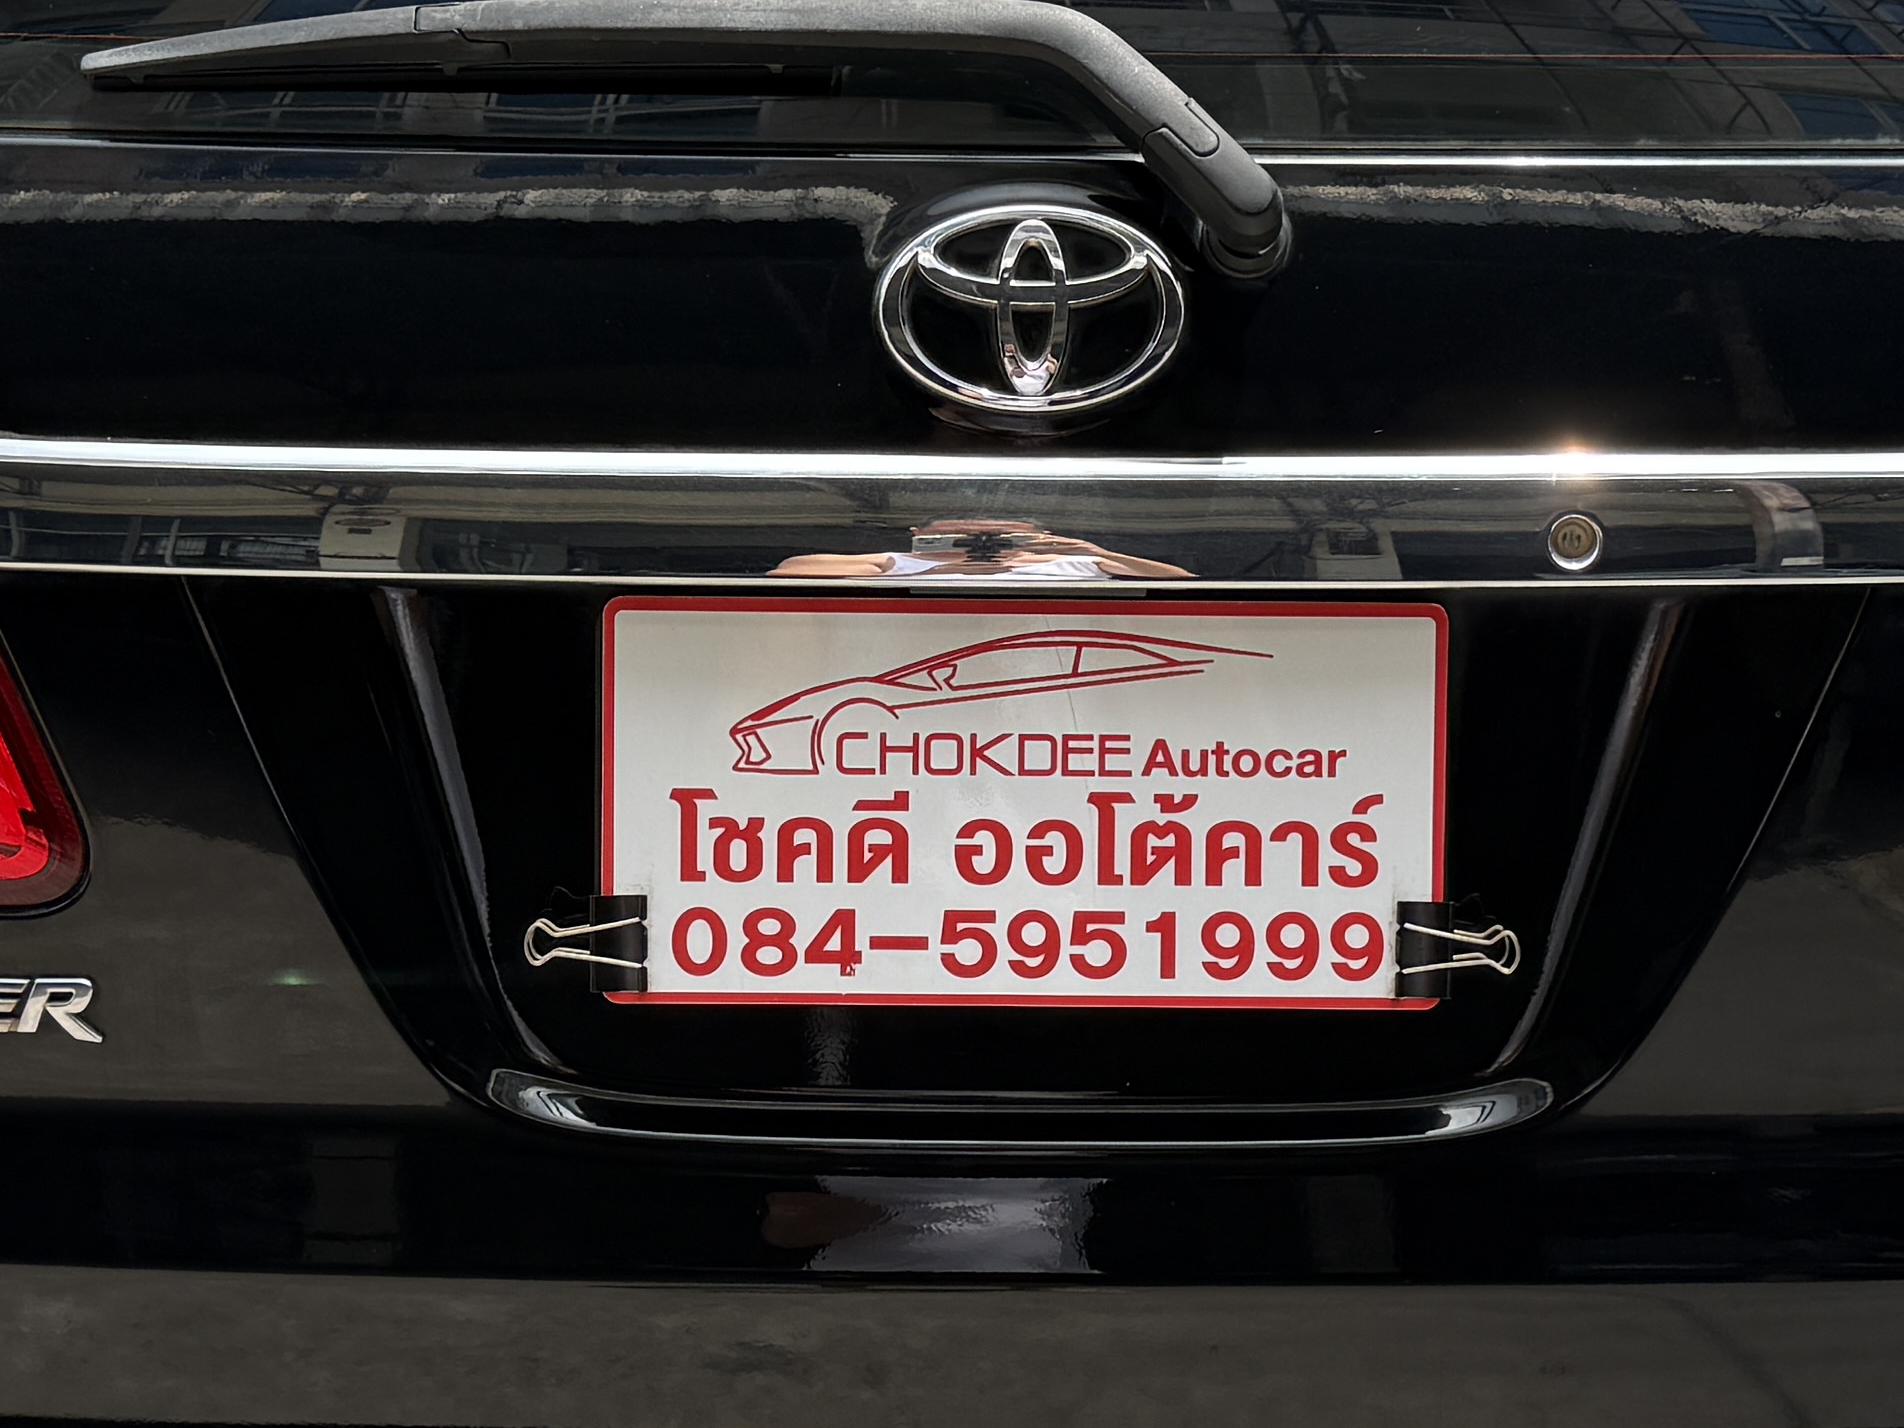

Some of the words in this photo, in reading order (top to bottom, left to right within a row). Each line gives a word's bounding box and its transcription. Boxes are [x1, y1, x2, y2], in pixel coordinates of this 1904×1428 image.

[834, 730, 1133, 777] CHOKDEE
[1142, 736, 1347, 779] Autocar
[670, 788, 909, 885] โชคดี
[954, 791, 1384, 888] ออโต้คาร์
[671, 906, 1384, 980] 084-5951999
